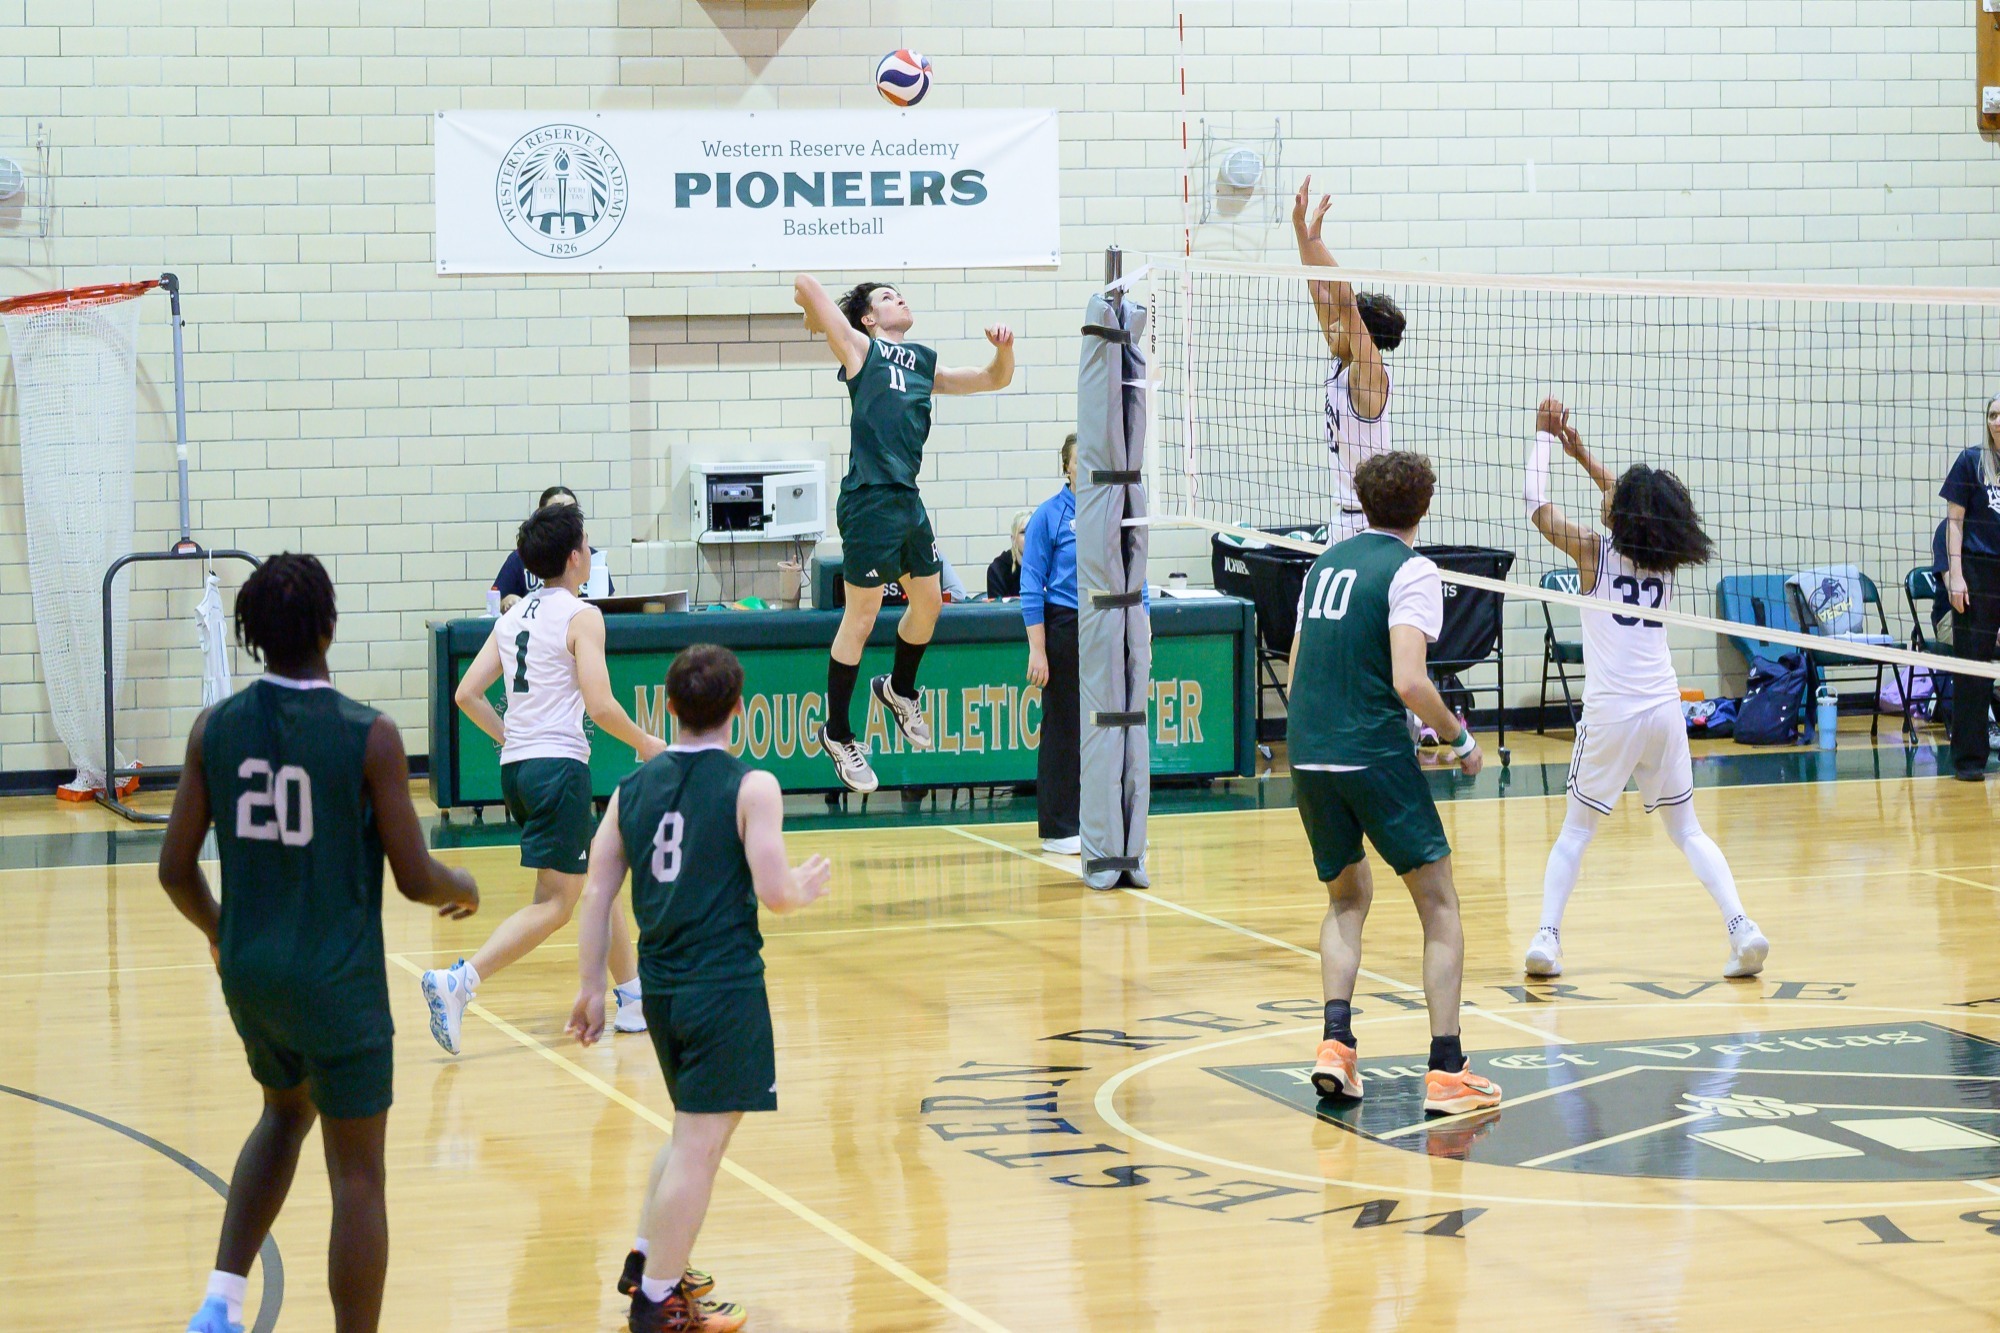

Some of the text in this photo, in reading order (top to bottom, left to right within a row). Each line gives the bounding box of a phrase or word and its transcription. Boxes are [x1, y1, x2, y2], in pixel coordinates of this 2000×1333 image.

[701, 139, 960, 160] Western Reserve Academy
[501, 128, 624, 223] WESTERN RESERVE ACADEMY
[674, 169, 988, 209] PIONEERS
[549, 243, 578, 255] 1826
[783, 218, 884, 236] Basketball
[875, 340, 916, 371] WRA
[888, 365, 907, 393] 11
[1307, 566, 1358, 621] 10
[1612, 575, 1664, 628] 32
[512, 630, 531, 694] 1
[236, 757, 314, 848] 20
[651, 811, 685, 884] 8
[1604, 1030, 1929, 1060] Veritas
[919, 1060, 1489, 1239] WESTERN
